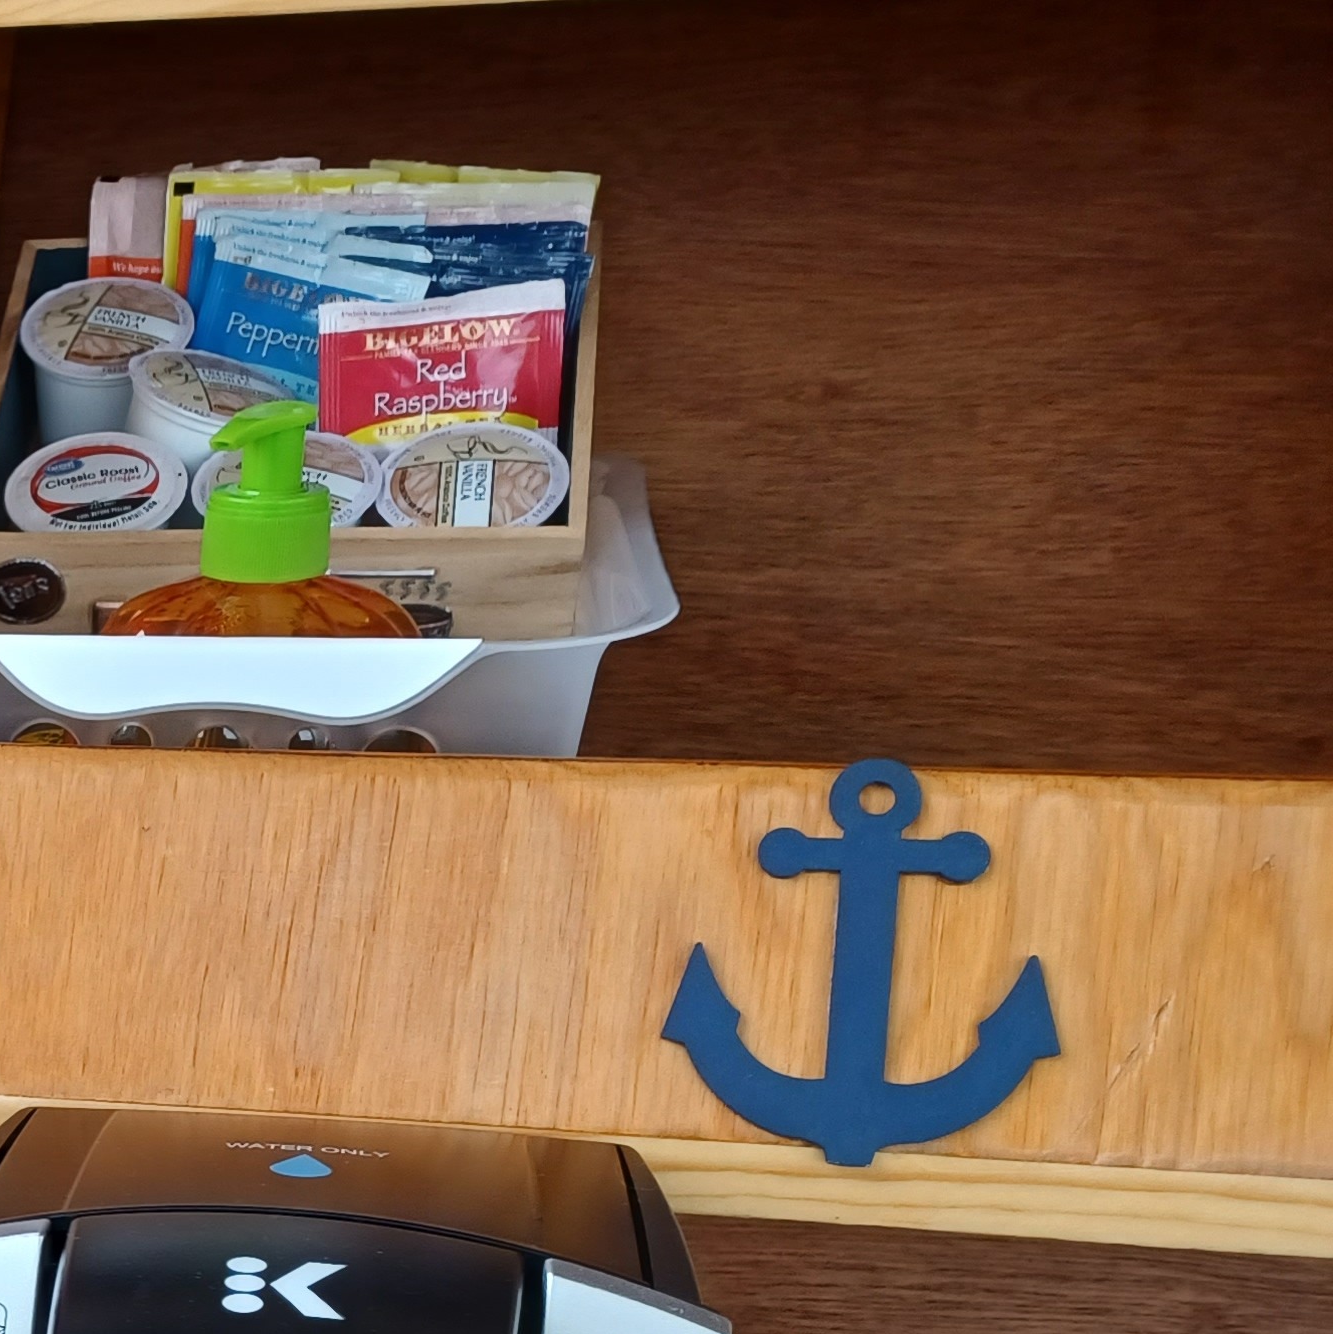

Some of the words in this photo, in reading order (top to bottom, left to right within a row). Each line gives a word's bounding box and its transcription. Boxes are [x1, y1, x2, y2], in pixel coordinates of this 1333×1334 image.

[364, 318, 517, 351] BIGELOW
[416, 350, 467, 383] Red
[373, 380, 509, 425] Raspberry
[45, 473, 96, 490] Classic
[225, 1140, 314, 1155] WATER
[319, 1144, 390, 1160] ONLY
